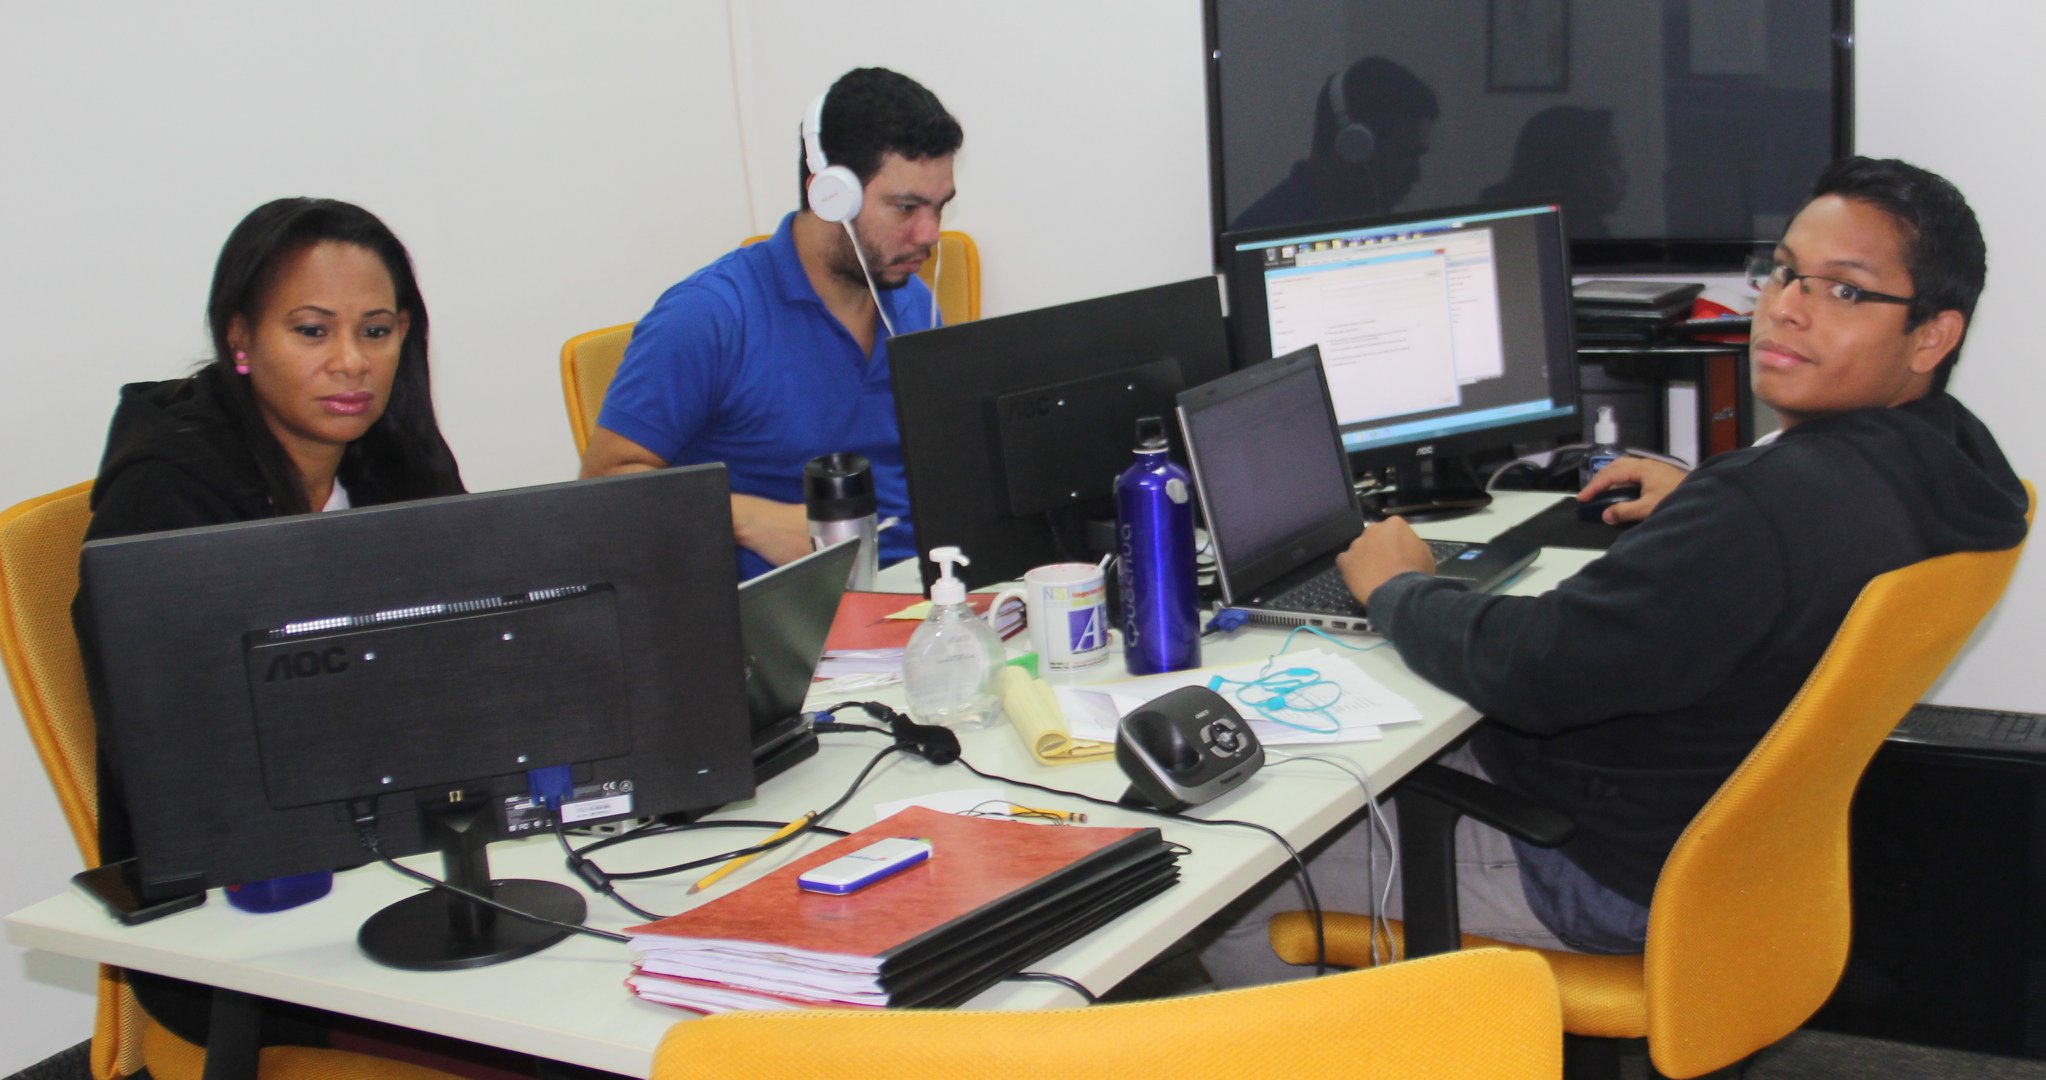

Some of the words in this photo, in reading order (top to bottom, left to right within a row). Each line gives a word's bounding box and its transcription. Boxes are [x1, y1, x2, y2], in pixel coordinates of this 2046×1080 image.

[1416, 446, 1433, 455] AOC
[1121, 523, 1139, 647] Quechua
[264, 646, 350, 683] AOC
